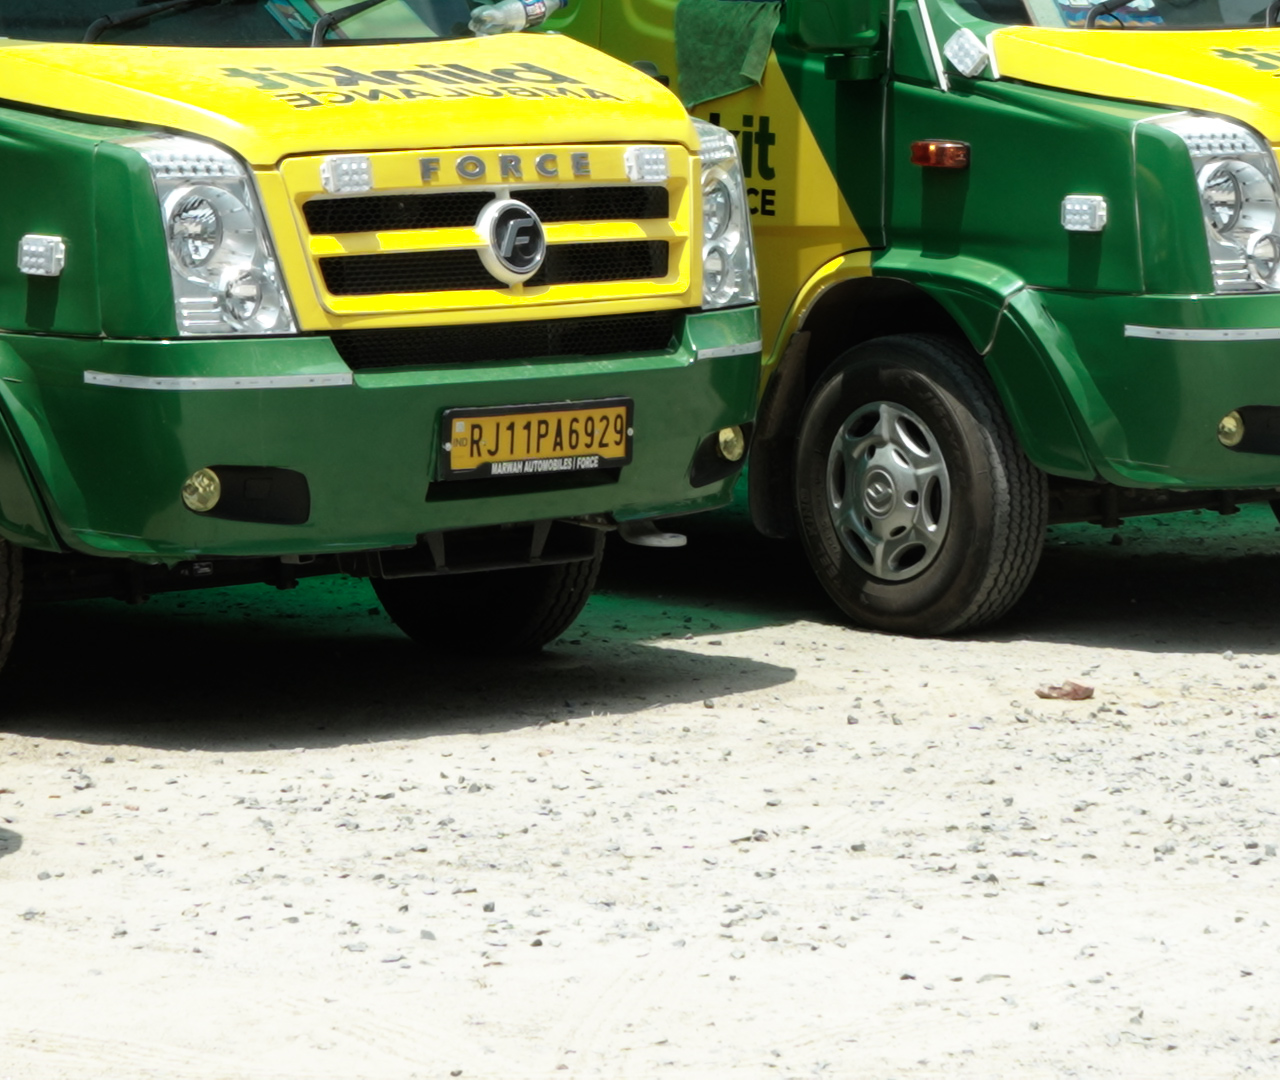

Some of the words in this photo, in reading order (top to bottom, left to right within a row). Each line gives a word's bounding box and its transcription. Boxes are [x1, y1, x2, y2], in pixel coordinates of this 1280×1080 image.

[419, 152, 591, 182] FORCE
[452, 437, 468, 448] IND
[470, 413, 625, 458] RJ11PA6929
[491, 461, 523, 475] MARWAH
[523, 457, 573, 473] AUTOMOBILES
[576, 455, 599, 470] FORCE
